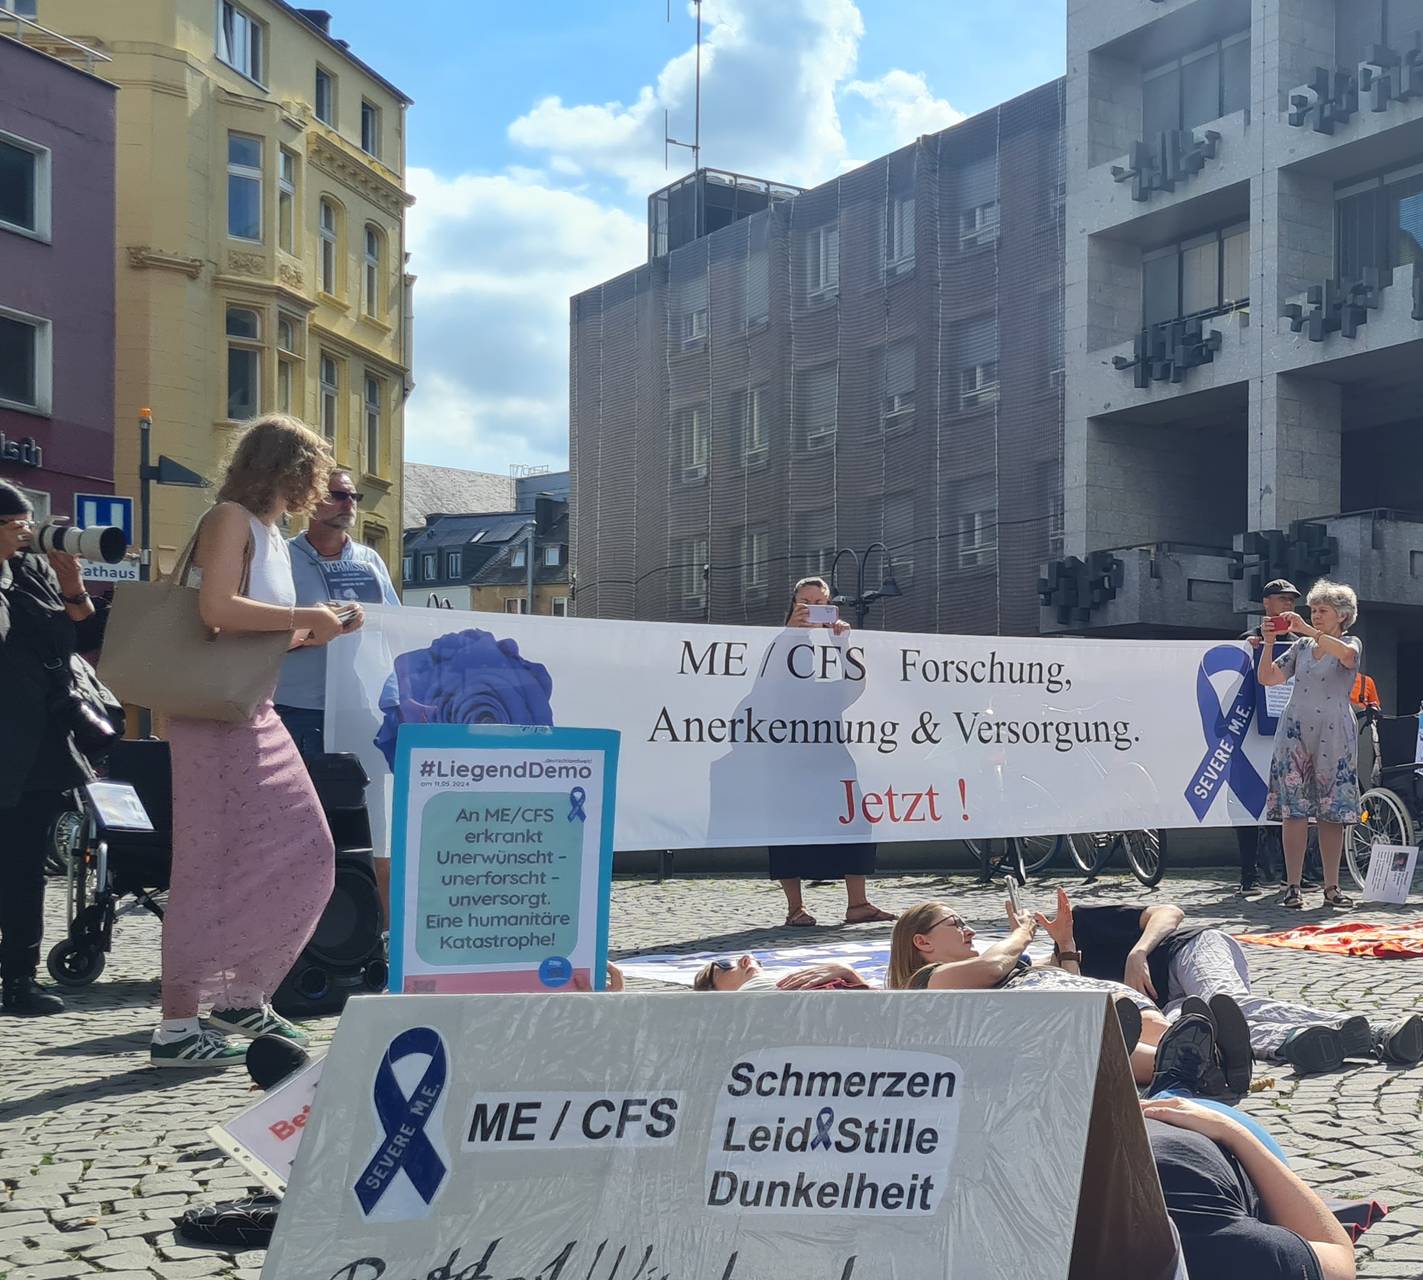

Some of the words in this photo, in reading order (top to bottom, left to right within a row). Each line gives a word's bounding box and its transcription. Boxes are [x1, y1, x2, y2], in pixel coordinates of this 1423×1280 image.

[82, 565, 136, 580] athaus
[677, 640, 748, 676] ME
[761, 642, 776, 677] /
[786, 643, 867, 681] CFS
[900, 649, 1072, 694] Forschung,
[646, 707, 900, 752] Anerkennung
[911, 710, 942, 745] &
[953, 711, 1141, 752] Versorgung.
[1193, 738, 1235, 800] SEVERE
[1228, 704, 1252, 736] M.E.
[420, 760, 592, 782] #LiegendDemo
[839, 778, 942, 825] Jetzt
[957, 777, 971, 822] !
[455, 808, 480, 823] An
[485, 807, 554, 824] ME/CFS
[465, 829, 543, 844] erkrankt
[436, 850, 554, 865] Unerwünscht
[441, 871, 547, 886] unerforscht
[448, 893, 551, 909] unversorgt.
[426, 914, 463, 929] Eine
[468, 912, 571, 927] humanitäre
[440, 933, 555, 951] Katastrophe!
[726, 1062, 957, 1098] Schmerzen
[467, 1101, 542, 1143] ME
[550, 1100, 571, 1141] /
[581, 1097, 679, 1140] CFS
[365, 1123, 417, 1190] SEVERE
[409, 1083, 440, 1116] M.E.
[706, 1170, 935, 1211] Dunkelheit
